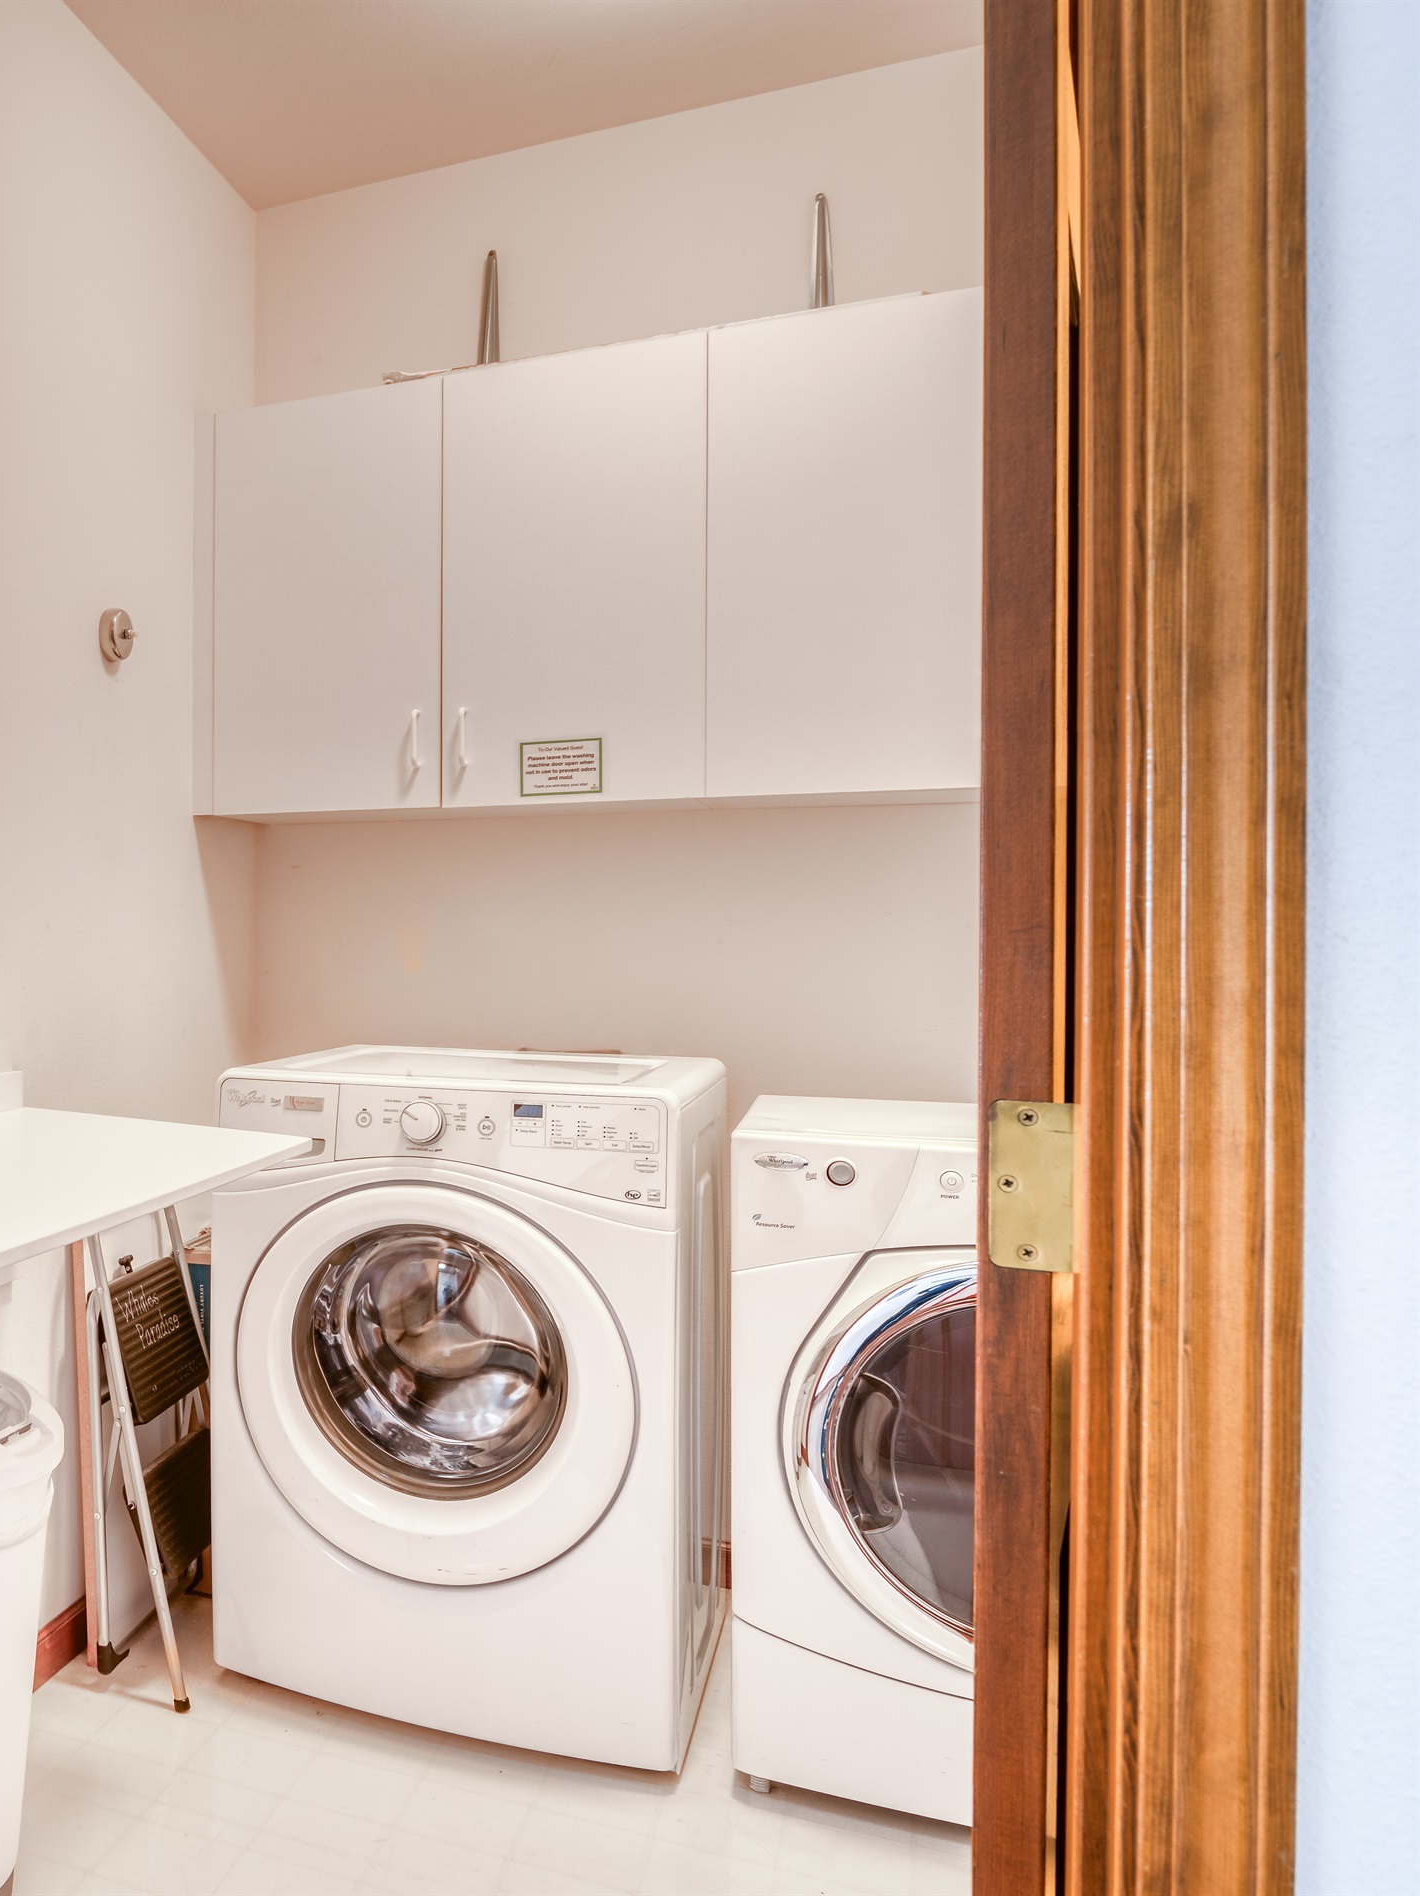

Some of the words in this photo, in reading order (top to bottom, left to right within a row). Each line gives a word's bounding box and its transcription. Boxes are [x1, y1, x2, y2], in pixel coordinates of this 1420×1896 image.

[227, 1087, 266, 1107] Whirlpool
[768, 1157, 794, 1165] Whirlpool
[135, 1308, 180, 1349] Paradise
